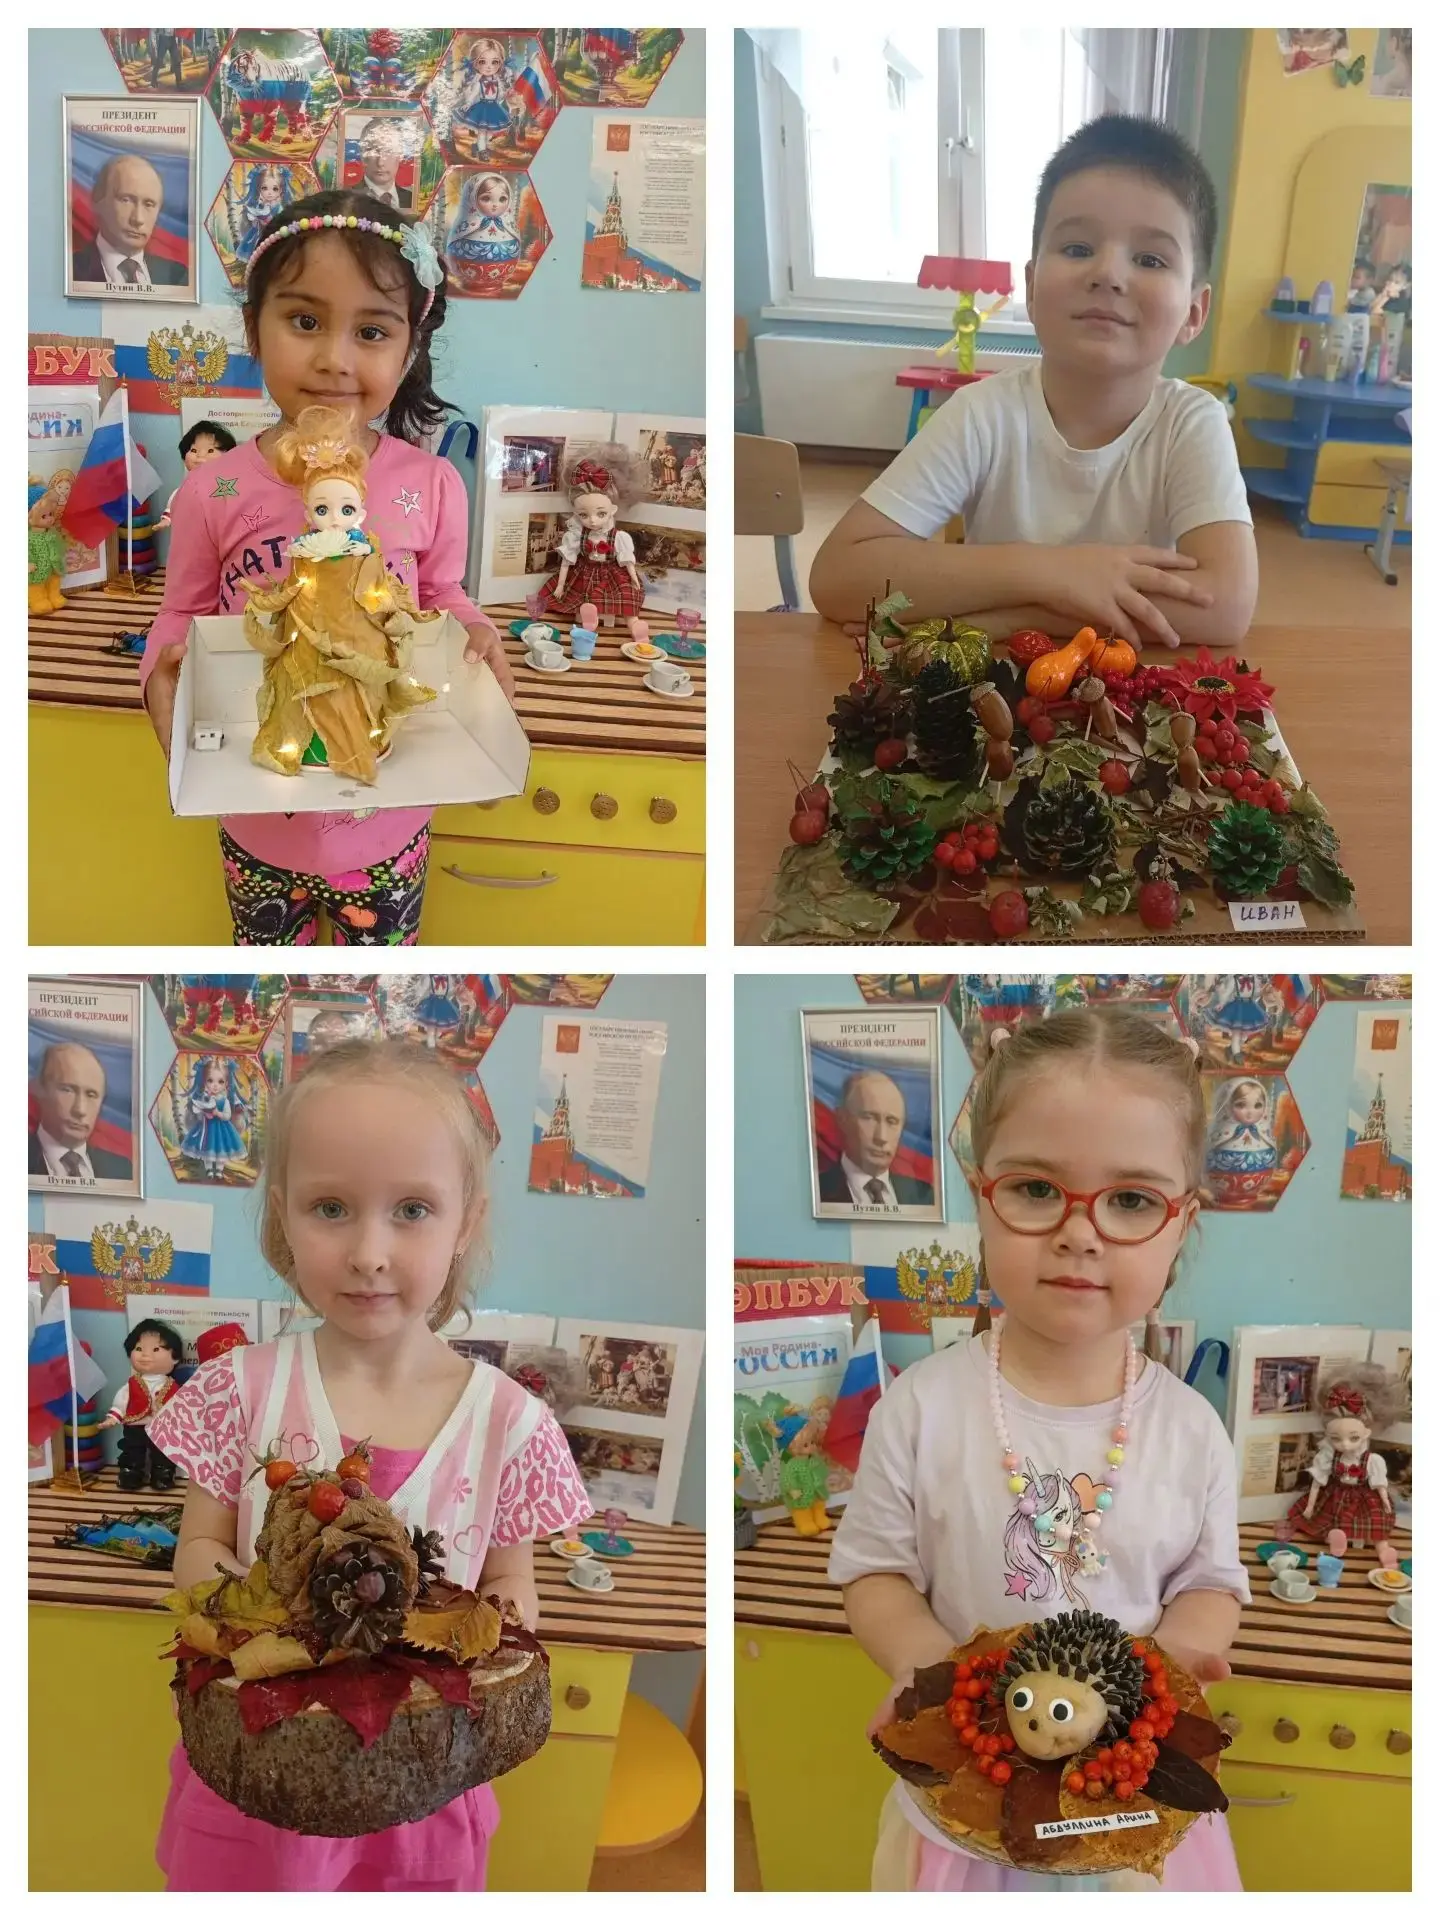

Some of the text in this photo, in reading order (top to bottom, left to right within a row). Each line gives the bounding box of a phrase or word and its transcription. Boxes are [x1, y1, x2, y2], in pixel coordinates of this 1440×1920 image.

[102, 111, 158, 120] ПРЕЗИДЕНТ
[134, 125, 186, 134] ФЕДЕРАЦИИ
[105, 283, 155, 293] Путин В.В.
[34, 345, 118, 378] БУК
[28, 411, 67, 423] дина-
[1241, 904, 1296, 920] ИВАН
[39, 993, 98, 1006] ПРЕЗИДЕНТ
[74, 1011, 128, 1022] ФЕДЕРАЦИИ
[840, 1023, 896, 1034] ПРЕЗИДЕНТ
[873, 1037, 926, 1048] ФЕДЕРАЦИИ
[48, 1176, 77, 1185] Путин
[852, 1204, 881, 1213] Путин
[734, 1347, 838, 1376] ОССИЯ
[1042, 1818, 1111, 1836] АБДУЛЛИНА
